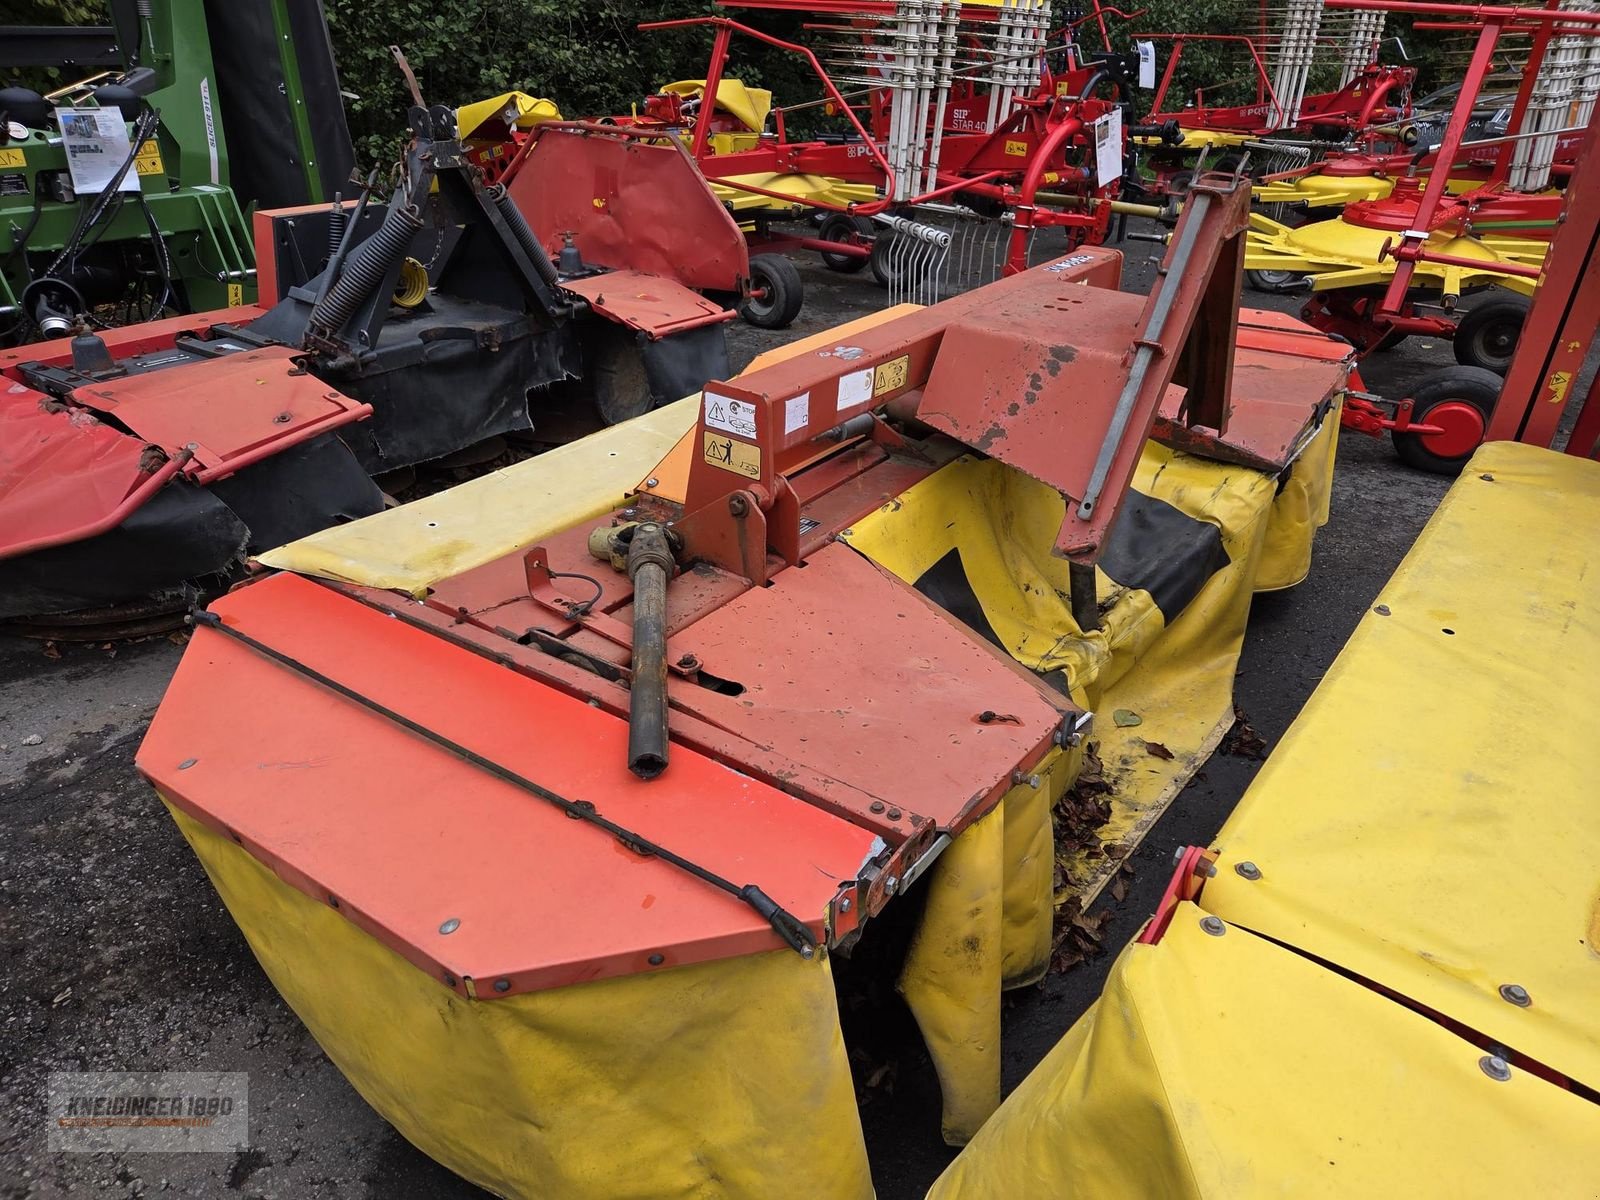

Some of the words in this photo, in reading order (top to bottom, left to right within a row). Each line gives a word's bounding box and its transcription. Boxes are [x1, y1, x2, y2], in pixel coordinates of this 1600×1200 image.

[203, 95, 211, 112] 911
[953, 108, 968, 119] SIP
[206, 113, 216, 148] SLICER
[952, 118, 973, 131] STAR
